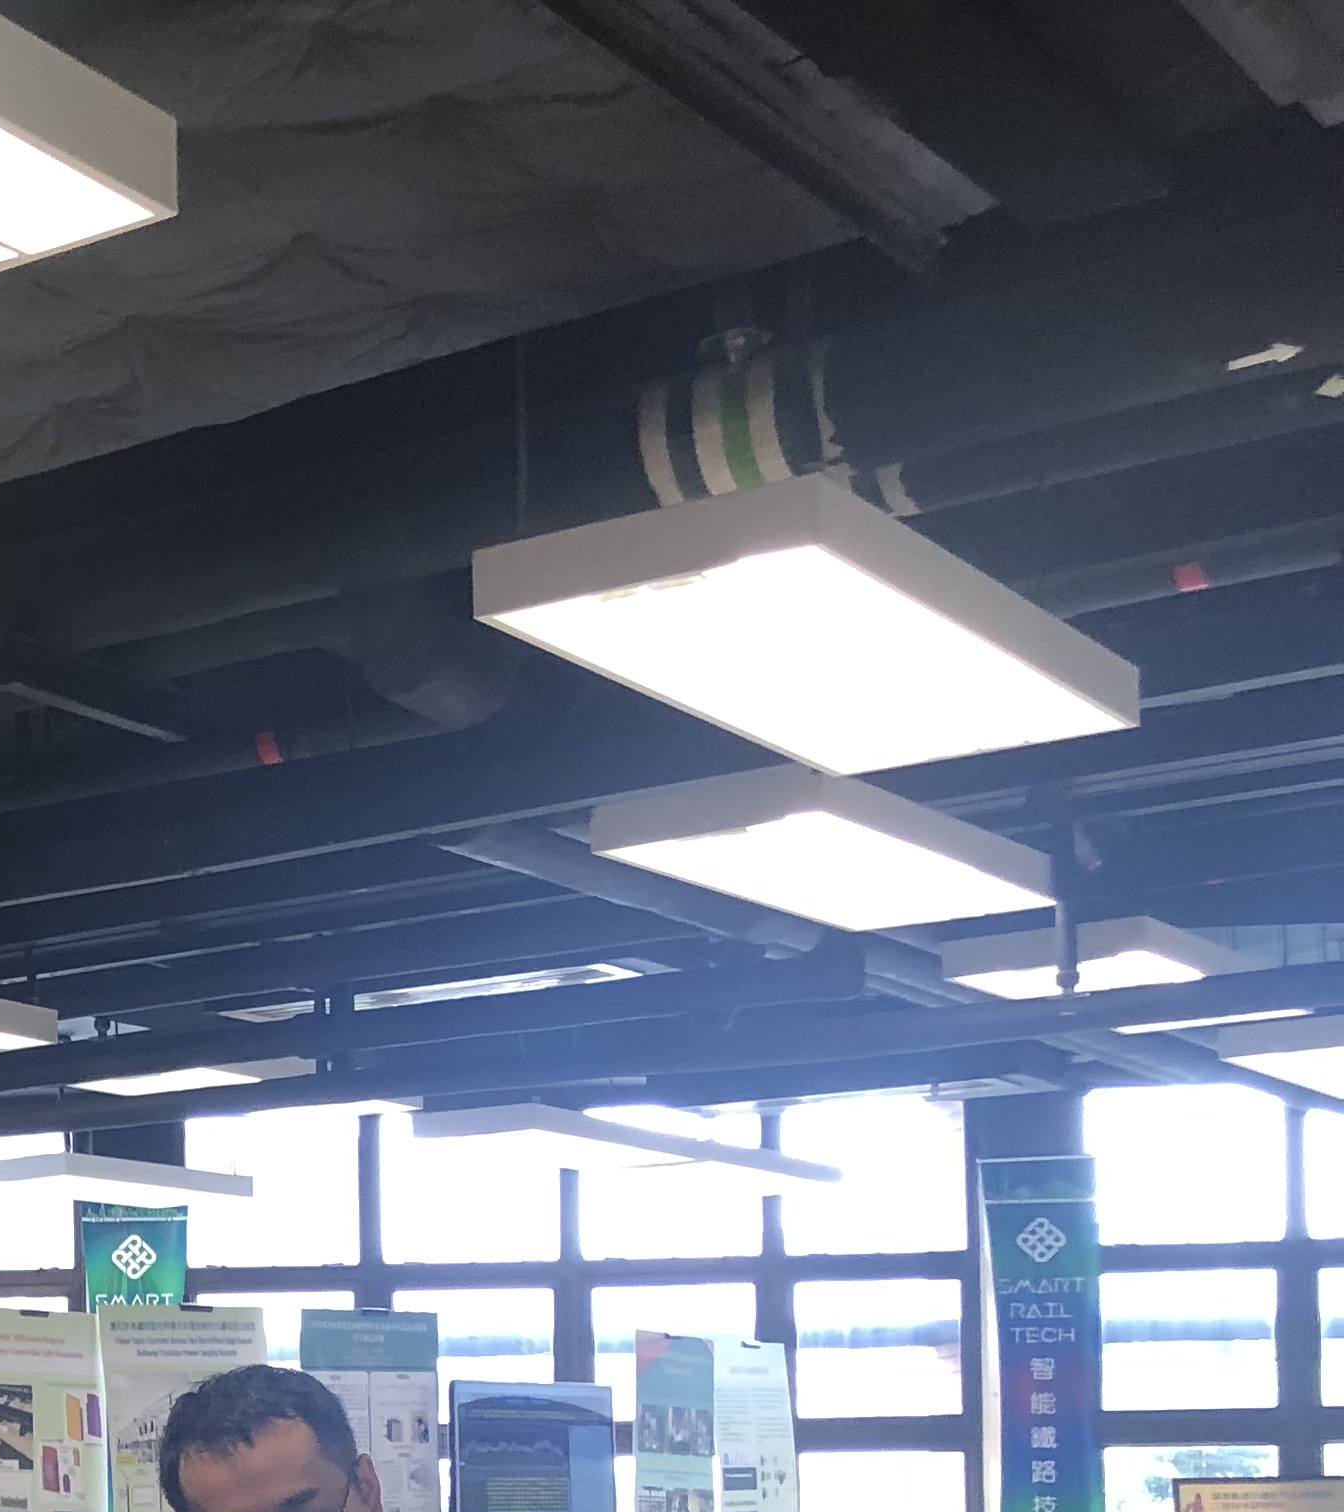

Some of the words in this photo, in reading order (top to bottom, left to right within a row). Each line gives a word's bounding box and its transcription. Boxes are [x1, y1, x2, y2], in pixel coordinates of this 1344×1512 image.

[996, 1277, 1085, 1295] SMART
[95, 1293, 174, 1306] SMART
[1009, 1303, 1073, 1319] RAIL
[1010, 1327, 1076, 1344] TECH
